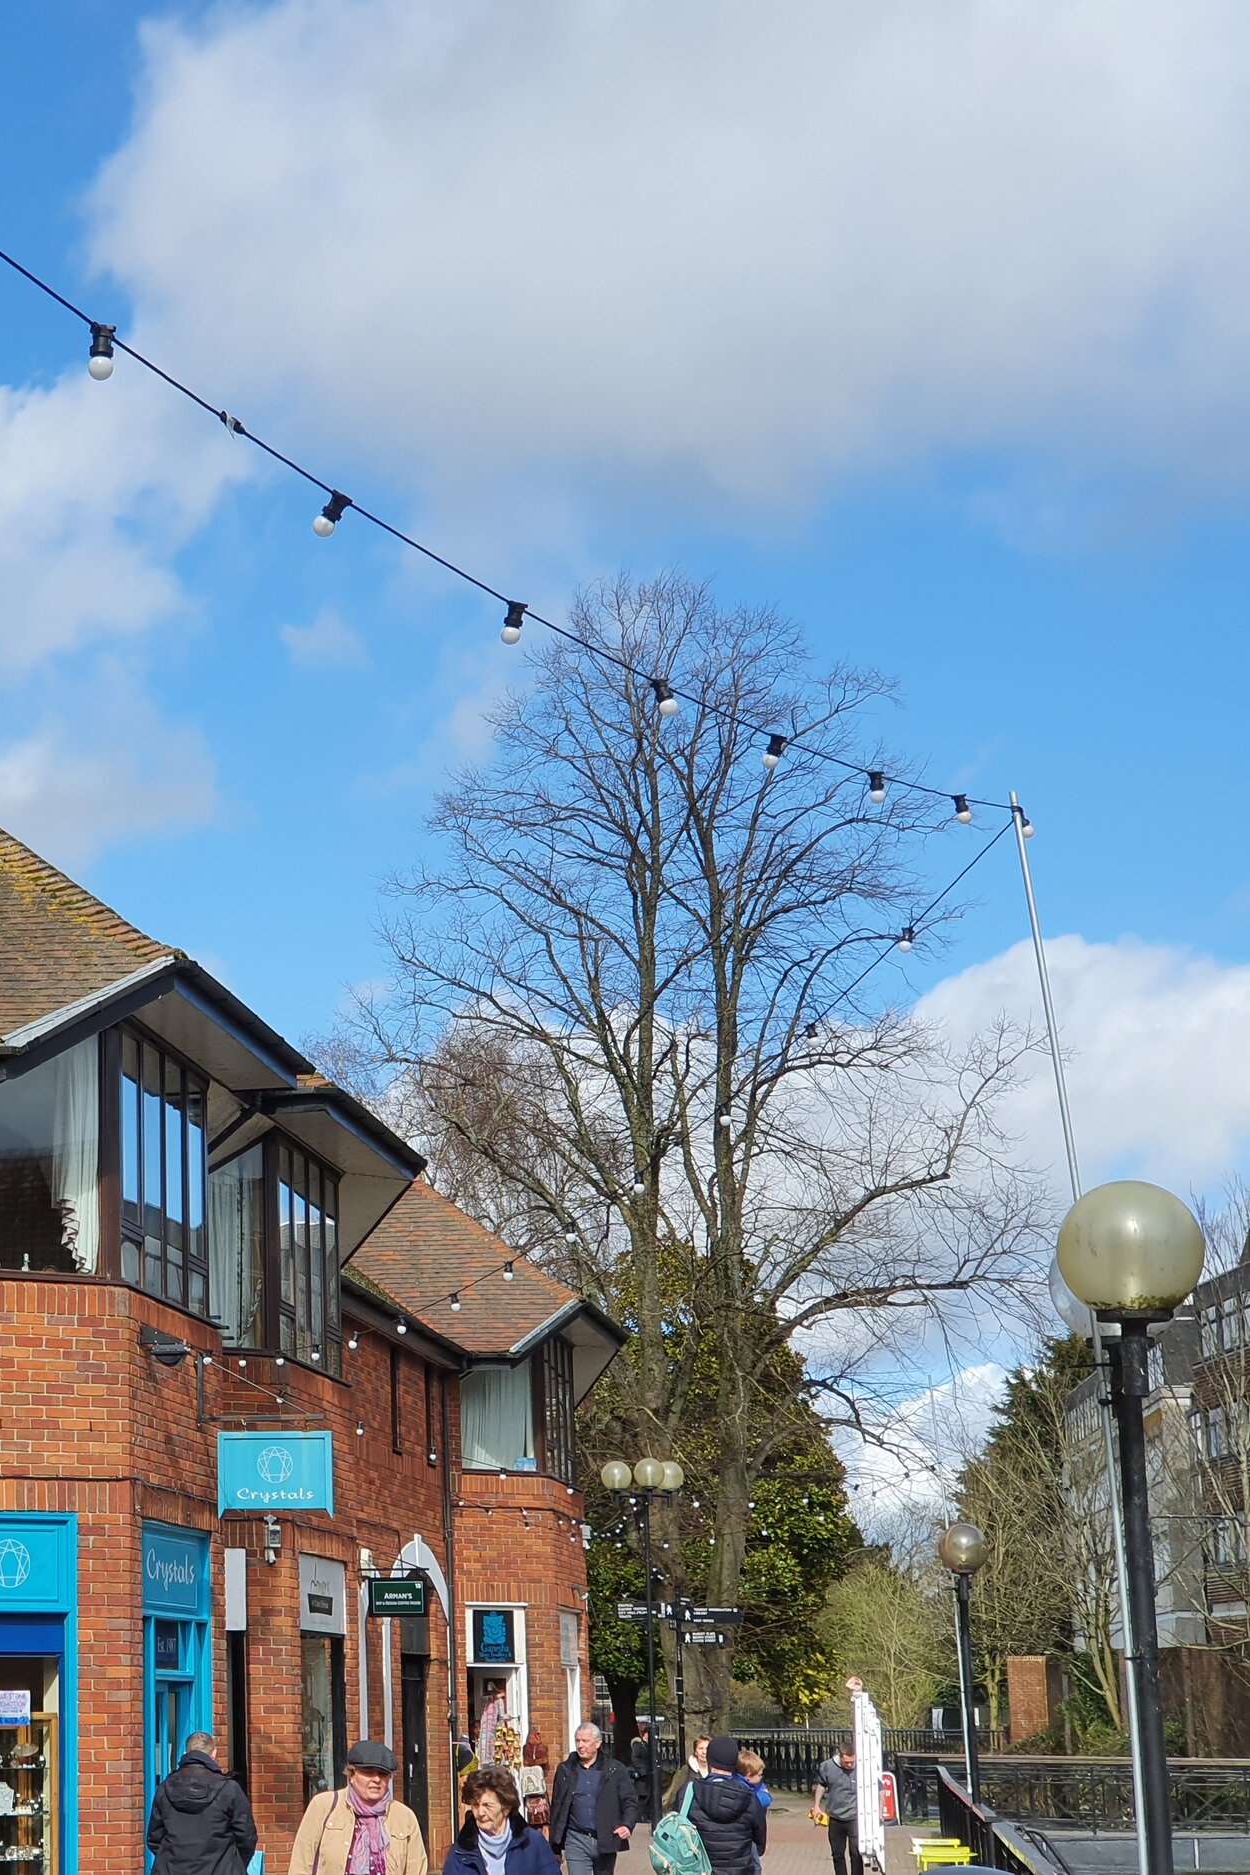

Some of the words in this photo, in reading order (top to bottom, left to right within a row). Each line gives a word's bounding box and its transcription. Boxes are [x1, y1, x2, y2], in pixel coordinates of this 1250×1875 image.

[236, 1487, 314, 1503] Crystals
[146, 1548, 195, 1591] Crystals
[384, 1592, 413, 1600] ARMAN'S
